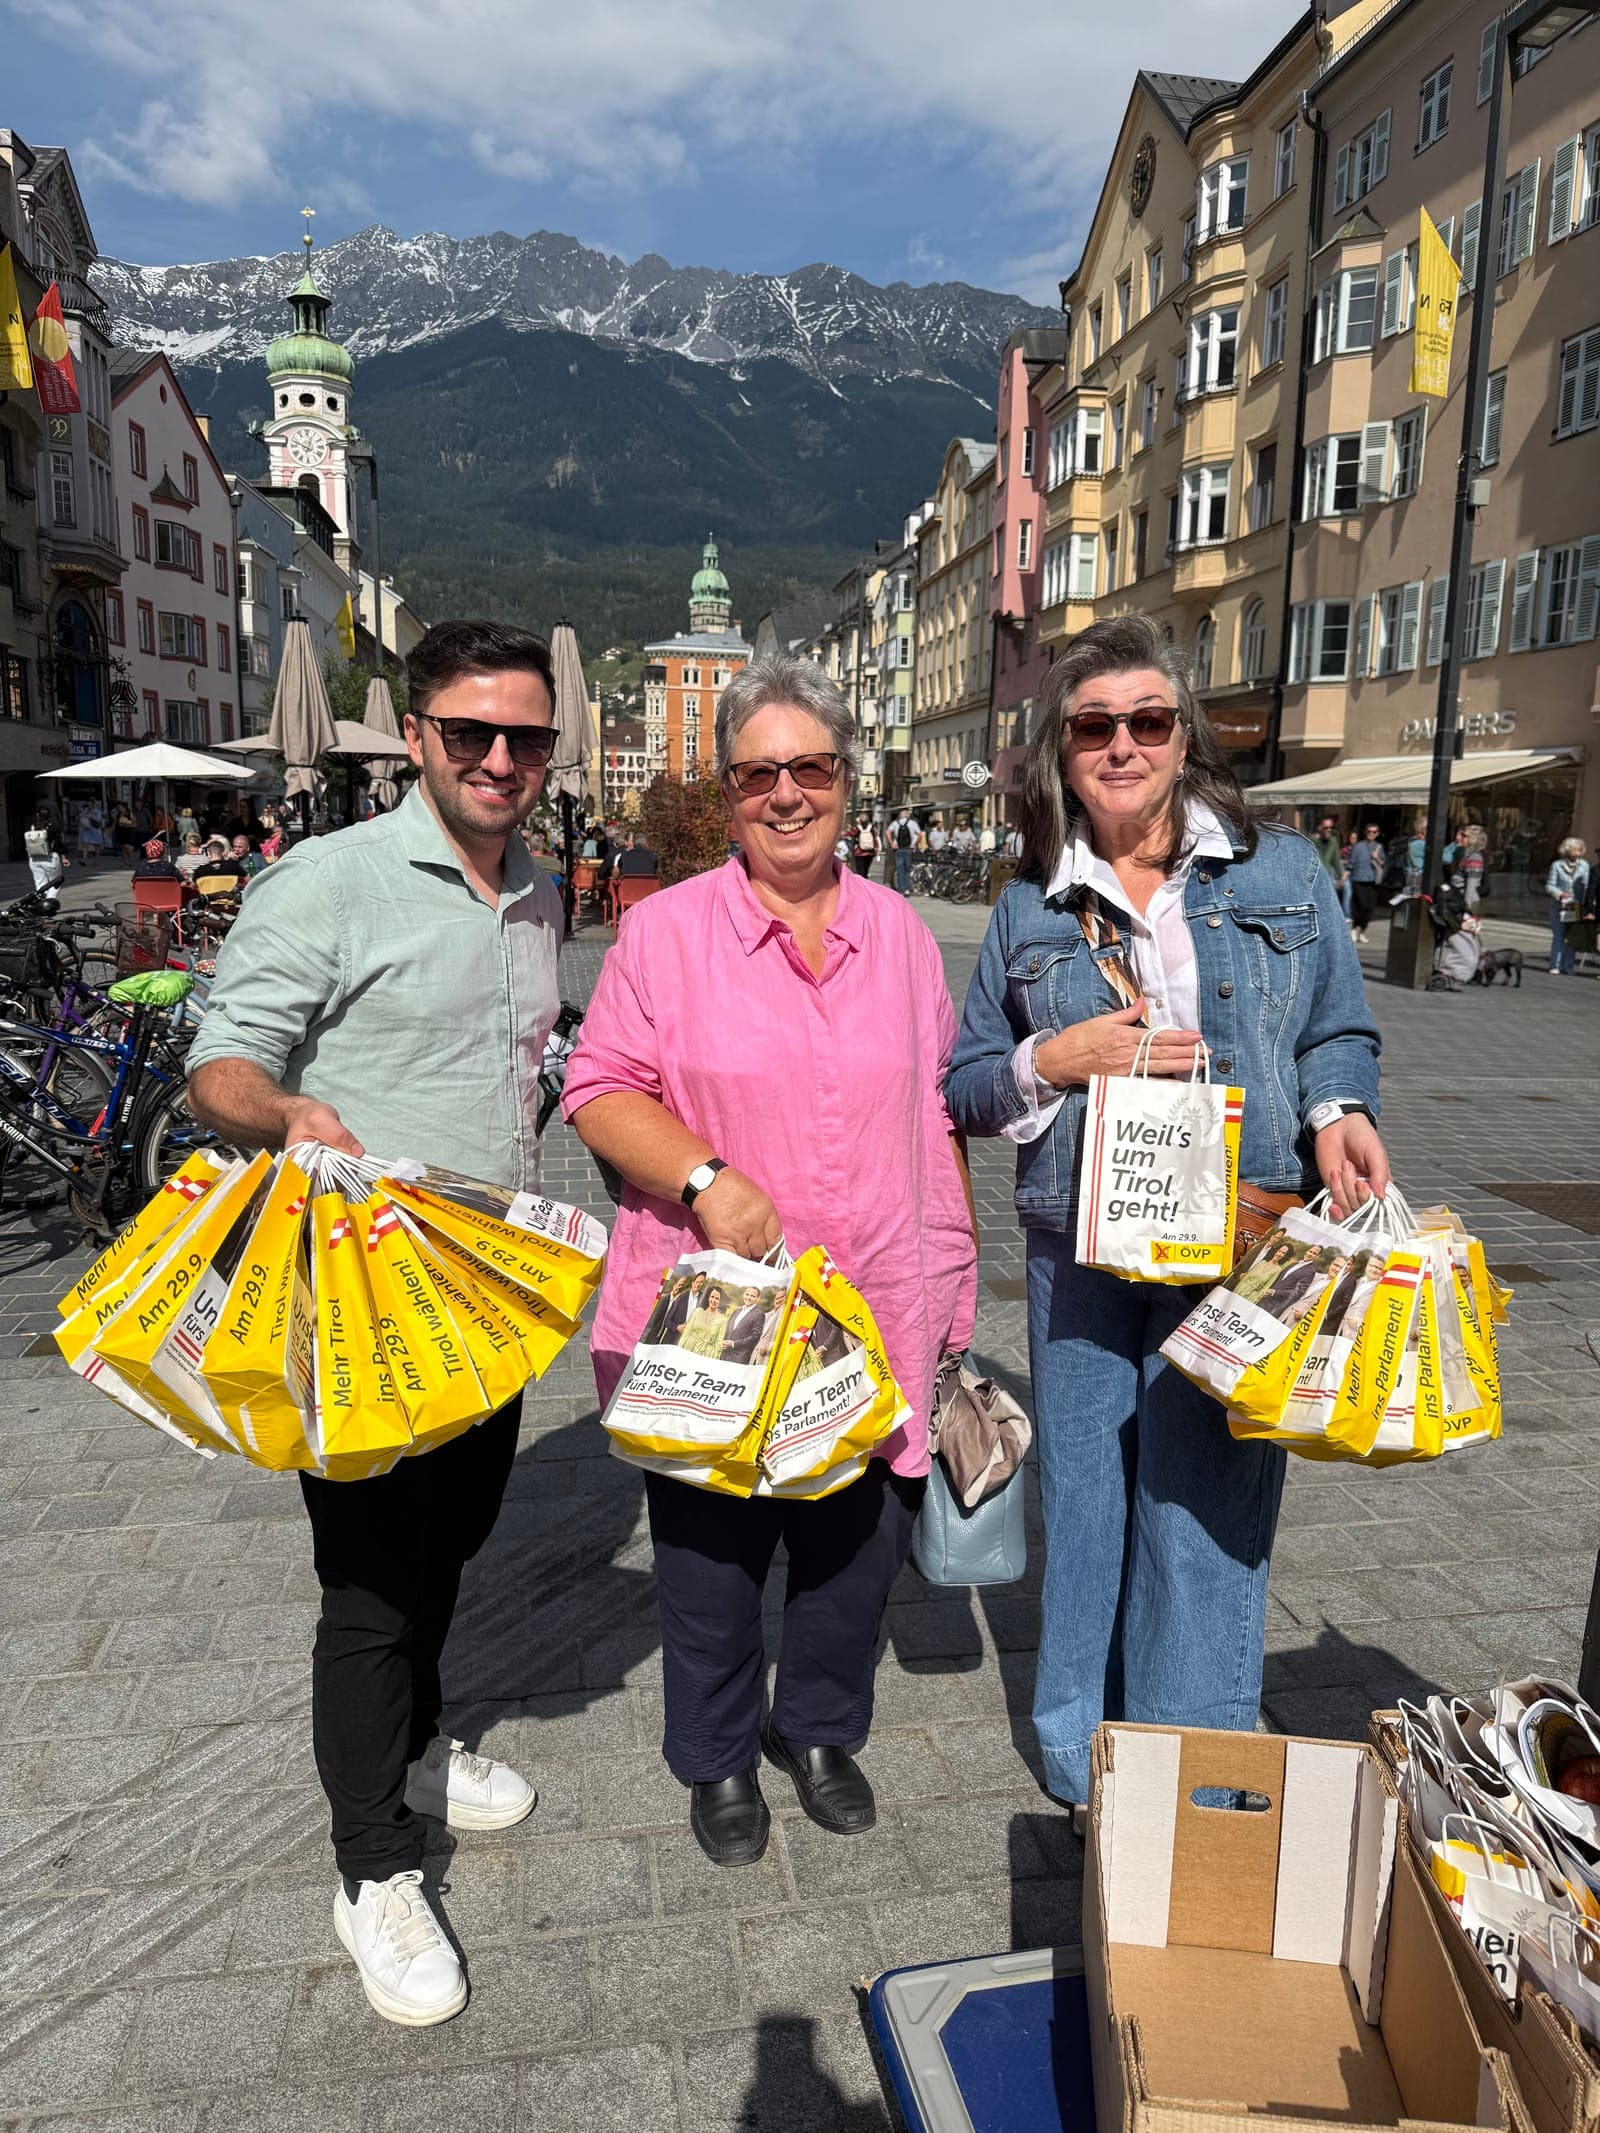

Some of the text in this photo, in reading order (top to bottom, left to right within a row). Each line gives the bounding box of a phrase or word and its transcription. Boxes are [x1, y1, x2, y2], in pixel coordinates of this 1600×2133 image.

[1116, 1120, 1192, 1148] Weil's
[1111, 1148, 1156, 1168] um
[1112, 1168, 1173, 1197] Tirol
[1107, 1199, 1179, 1223] geht!
[520, 1234, 562, 1259] Tirol
[1161, 1233, 1199, 1242] Am 29.9.
[1180, 1247, 1211, 1259] ÖVP
[476, 1236, 553, 1283] Am 29.9.
[76, 1256, 107, 1301] Mehr
[138, 1298, 170, 1333] Am
[166, 1253, 207, 1299] 29.9.
[230, 1264, 270, 1345] Am 29.9.
[270, 1295, 286, 1344] Tirol
[391, 1258, 464, 1378] Tirol wählen!
[509, 1288, 548, 1319] Tirol
[183, 1313, 205, 1341] fürs
[472, 1314, 510, 1353] Tirol
[1223, 1311, 1265, 1347] Team
[1375, 1297, 1404, 1393] Parlament!
[328, 1298, 353, 1408] Mehr Tirol
[379, 1313, 427, 1391] Am 29.9.
[377, 1372, 395, 1402] ins
[624, 1378, 720, 1406] fürs Parlament!
[633, 1359, 688, 1384] Unser
[691, 1371, 746, 1397] Team
[814, 1370, 863, 1406] Team
[1346, 1360, 1361, 1407] Mehr
[785, 1395, 851, 1434] Parlament!
[1371, 1394, 1386, 1421] ins
[1424, 1393, 1440, 1419] ins
